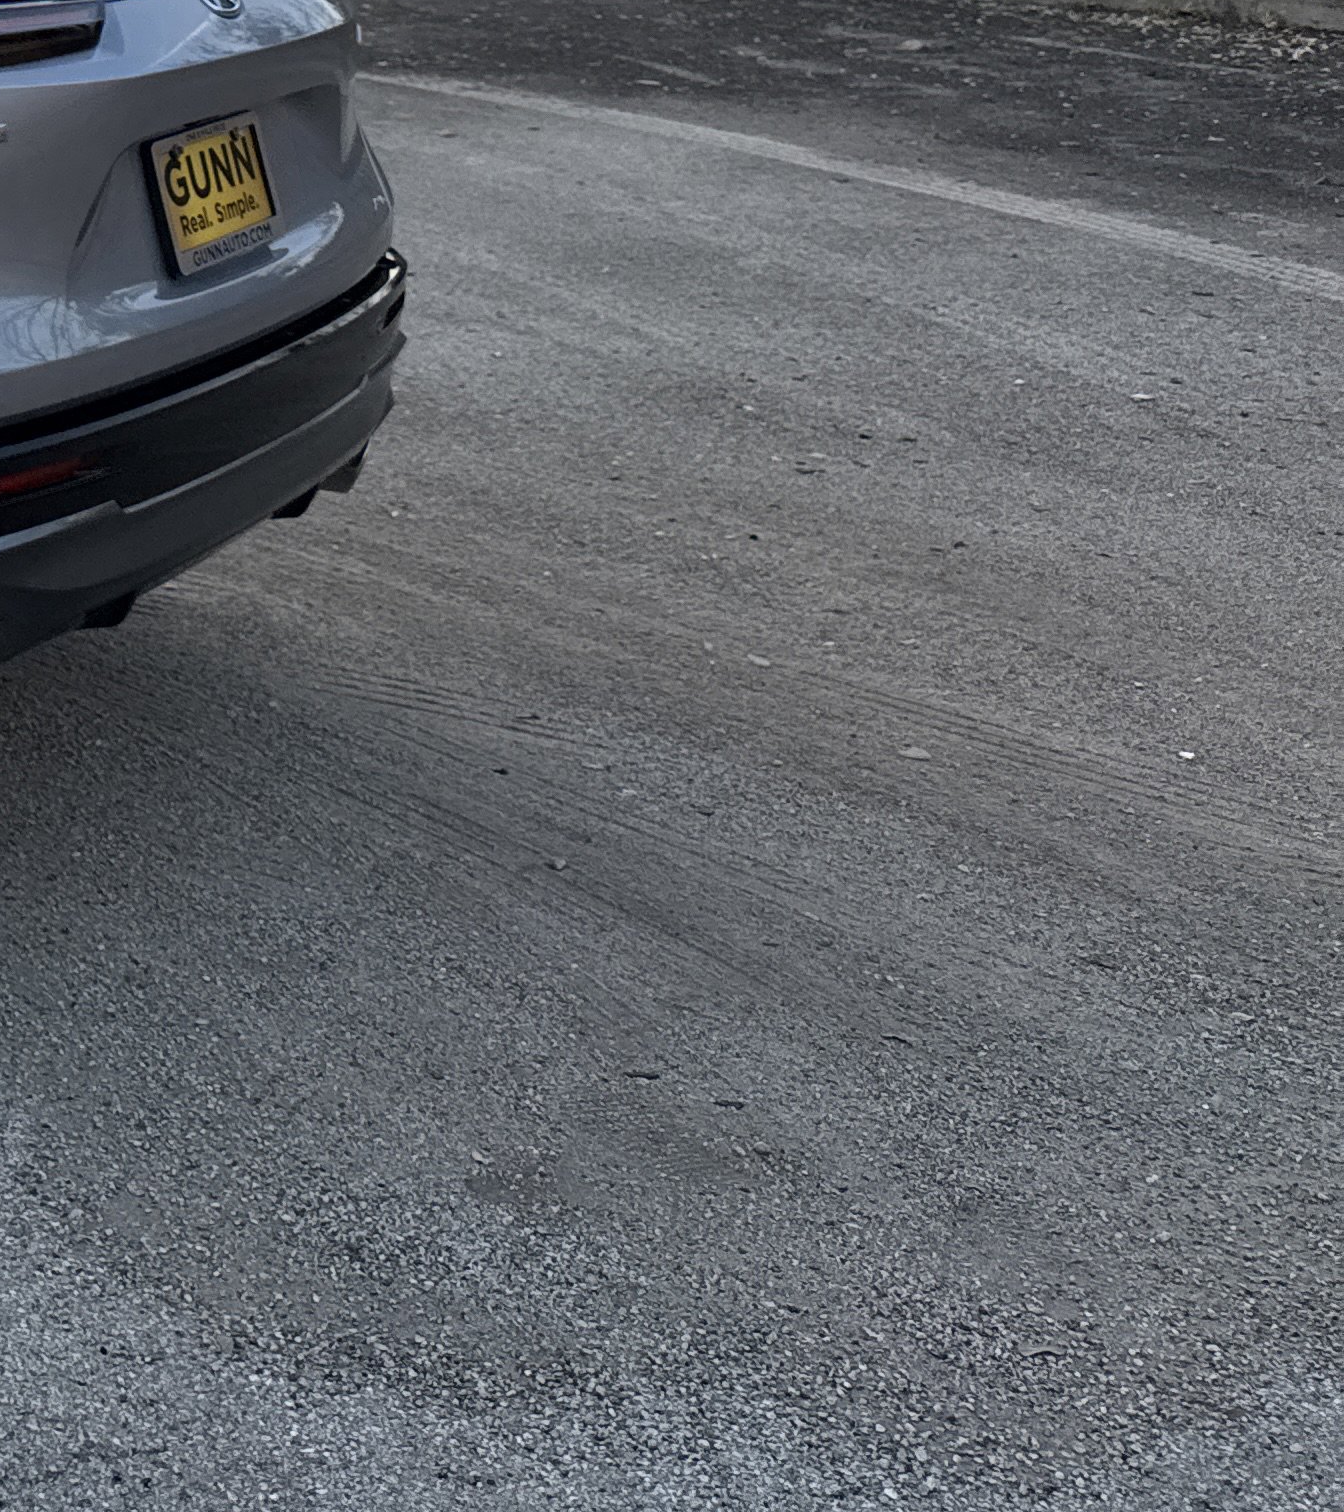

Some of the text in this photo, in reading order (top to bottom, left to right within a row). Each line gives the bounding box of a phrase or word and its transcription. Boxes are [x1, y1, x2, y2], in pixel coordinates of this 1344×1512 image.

[164, 135, 256, 207] GUNN
[179, 191, 261, 237] Real. Simple.
[192, 222, 273, 267] GUNNAUTO.COM
